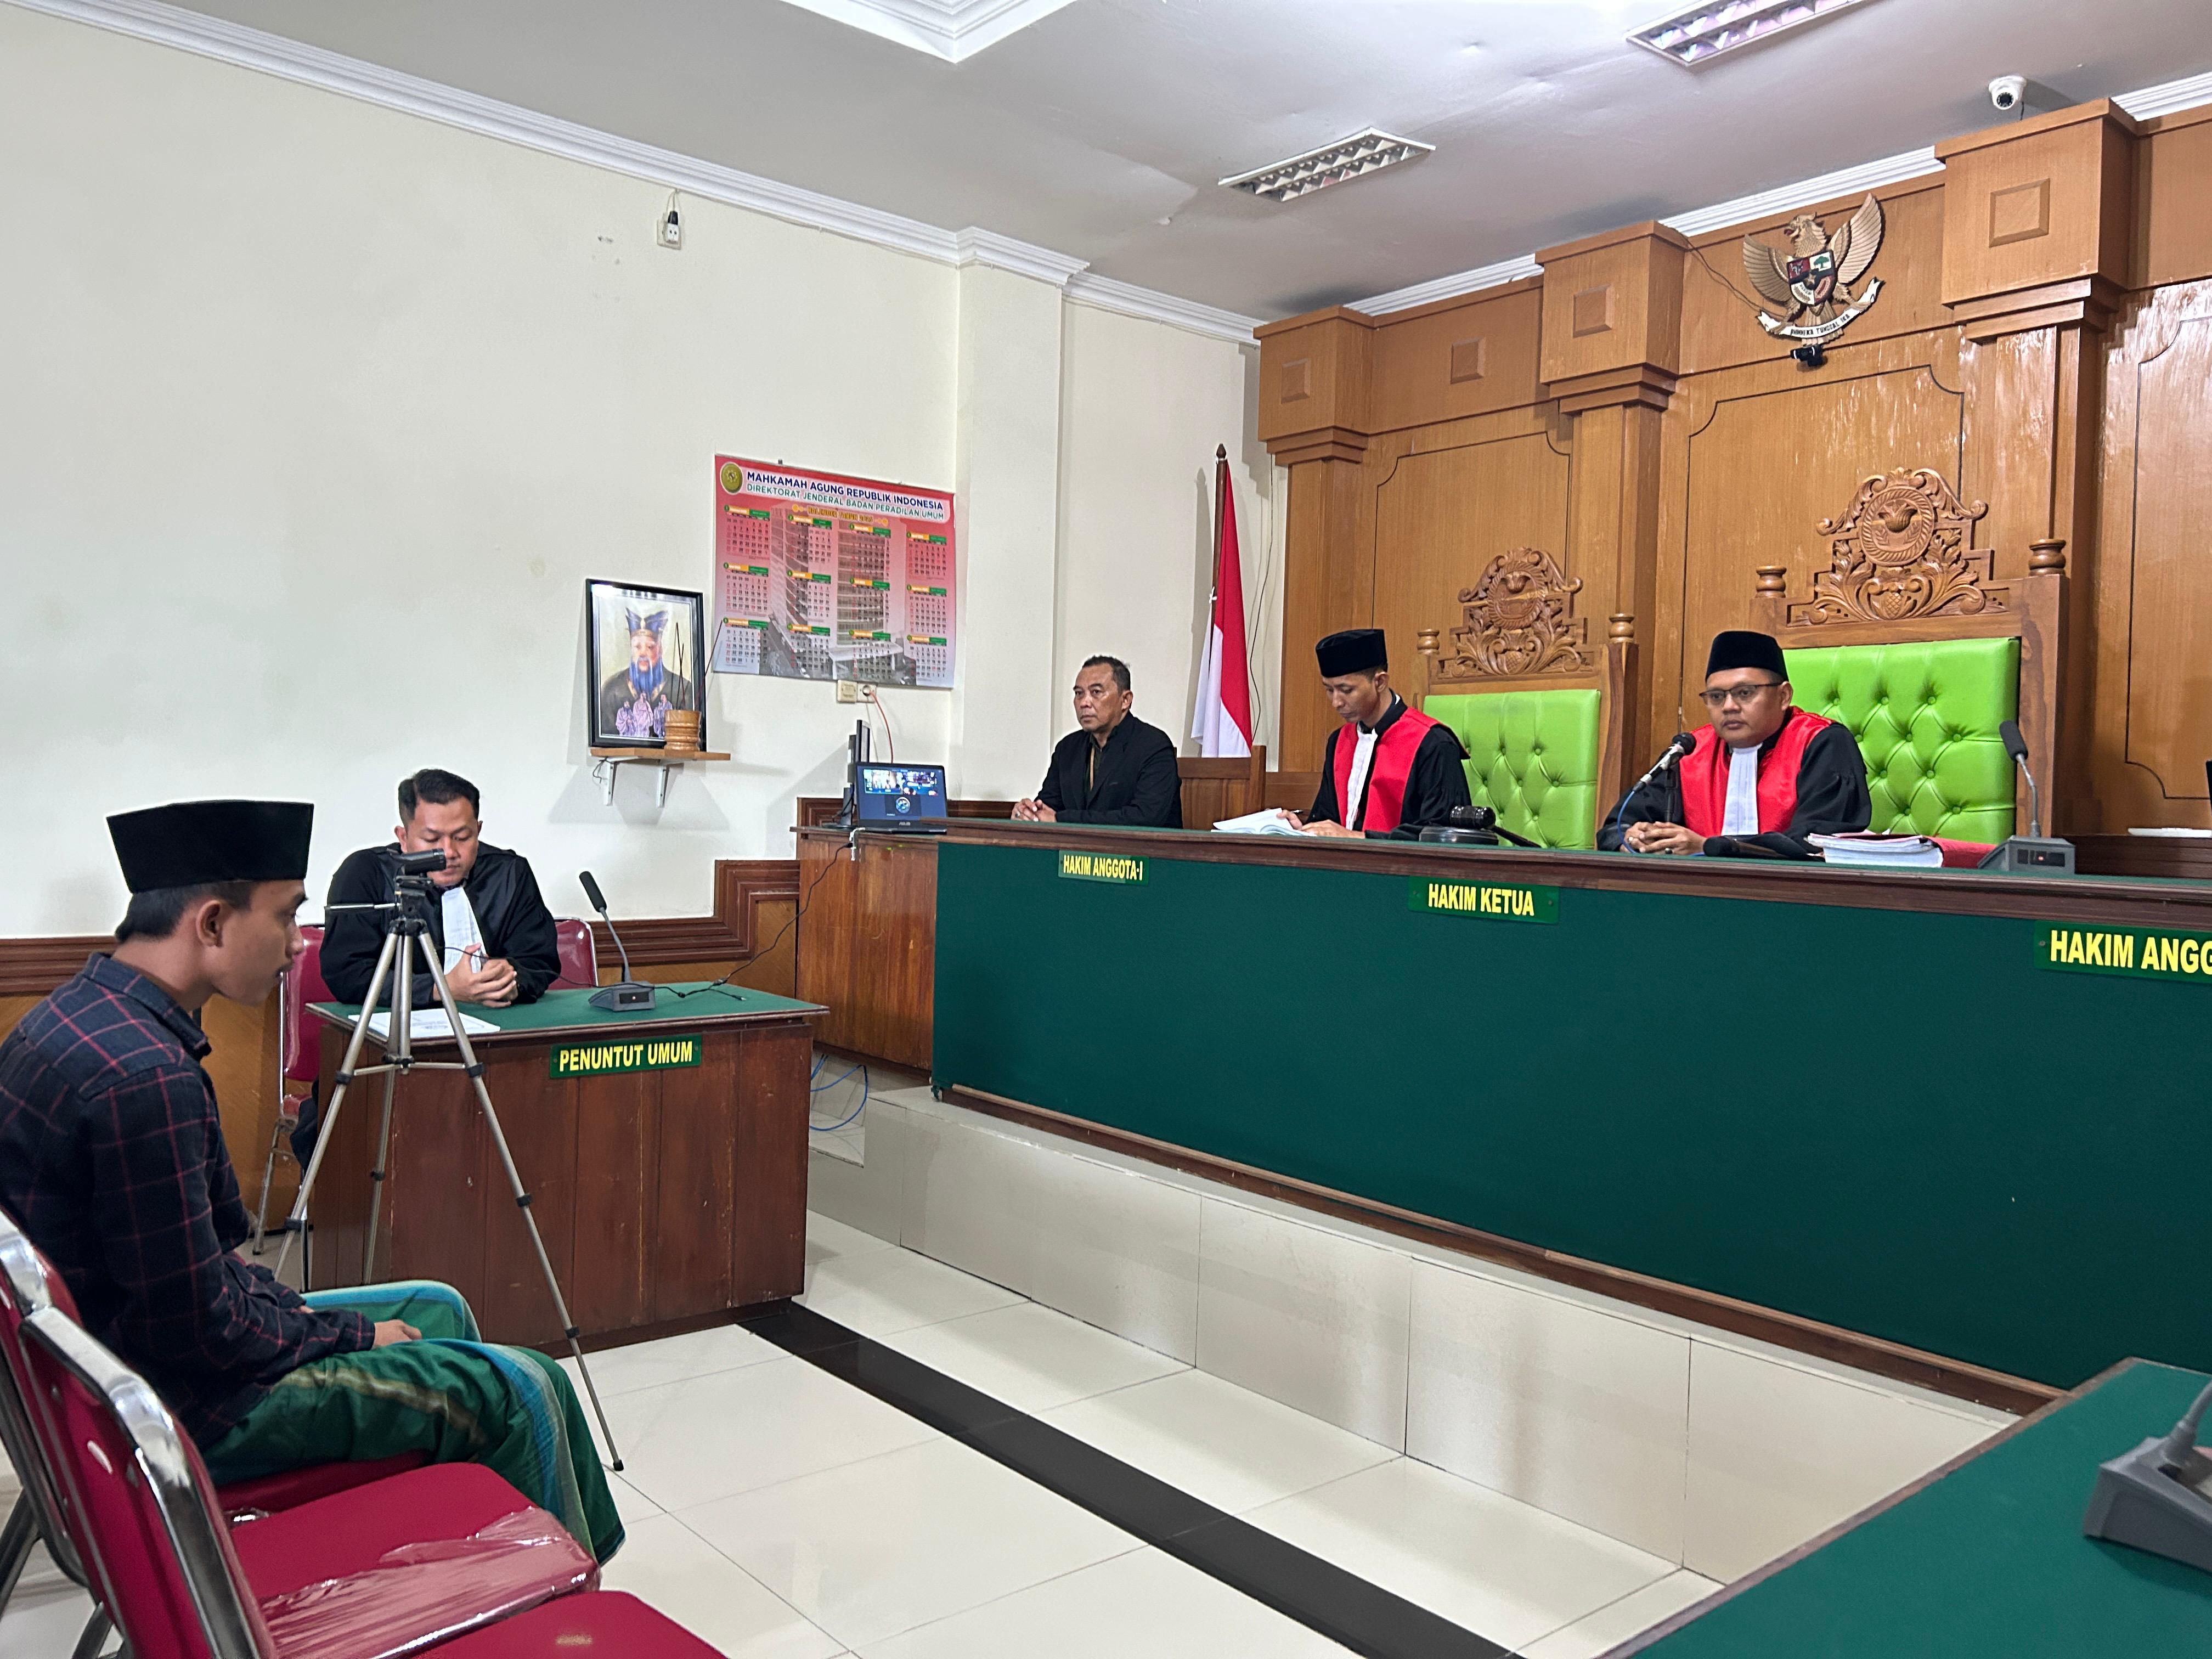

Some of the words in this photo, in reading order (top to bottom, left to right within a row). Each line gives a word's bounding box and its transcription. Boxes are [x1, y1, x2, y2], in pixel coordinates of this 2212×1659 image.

[747, 471, 808, 489] MAHKAMAH
[810, 482, 844, 495] AGUNG
[847, 488, 891, 503] REPUBLIK
[894, 496, 943, 510] INDONESIA
[747, 483, 800, 498] DIREKTORAT
[803, 492, 843, 505] JENDERAL
[846, 499, 873, 510] BADAN
[876, 504, 920, 517] PERADILAN
[922, 510, 944, 520] UMUM
[1063, 854, 1091, 876] HAKIM
[1428, 883, 1476, 911] HAKIM
[1480, 887, 1534, 916] KETUA
[2051, 929, 2134, 968] HAKIM
[560, 1044, 644, 1072] PENUNTUT
[647, 1041, 693, 1065] UMUM
